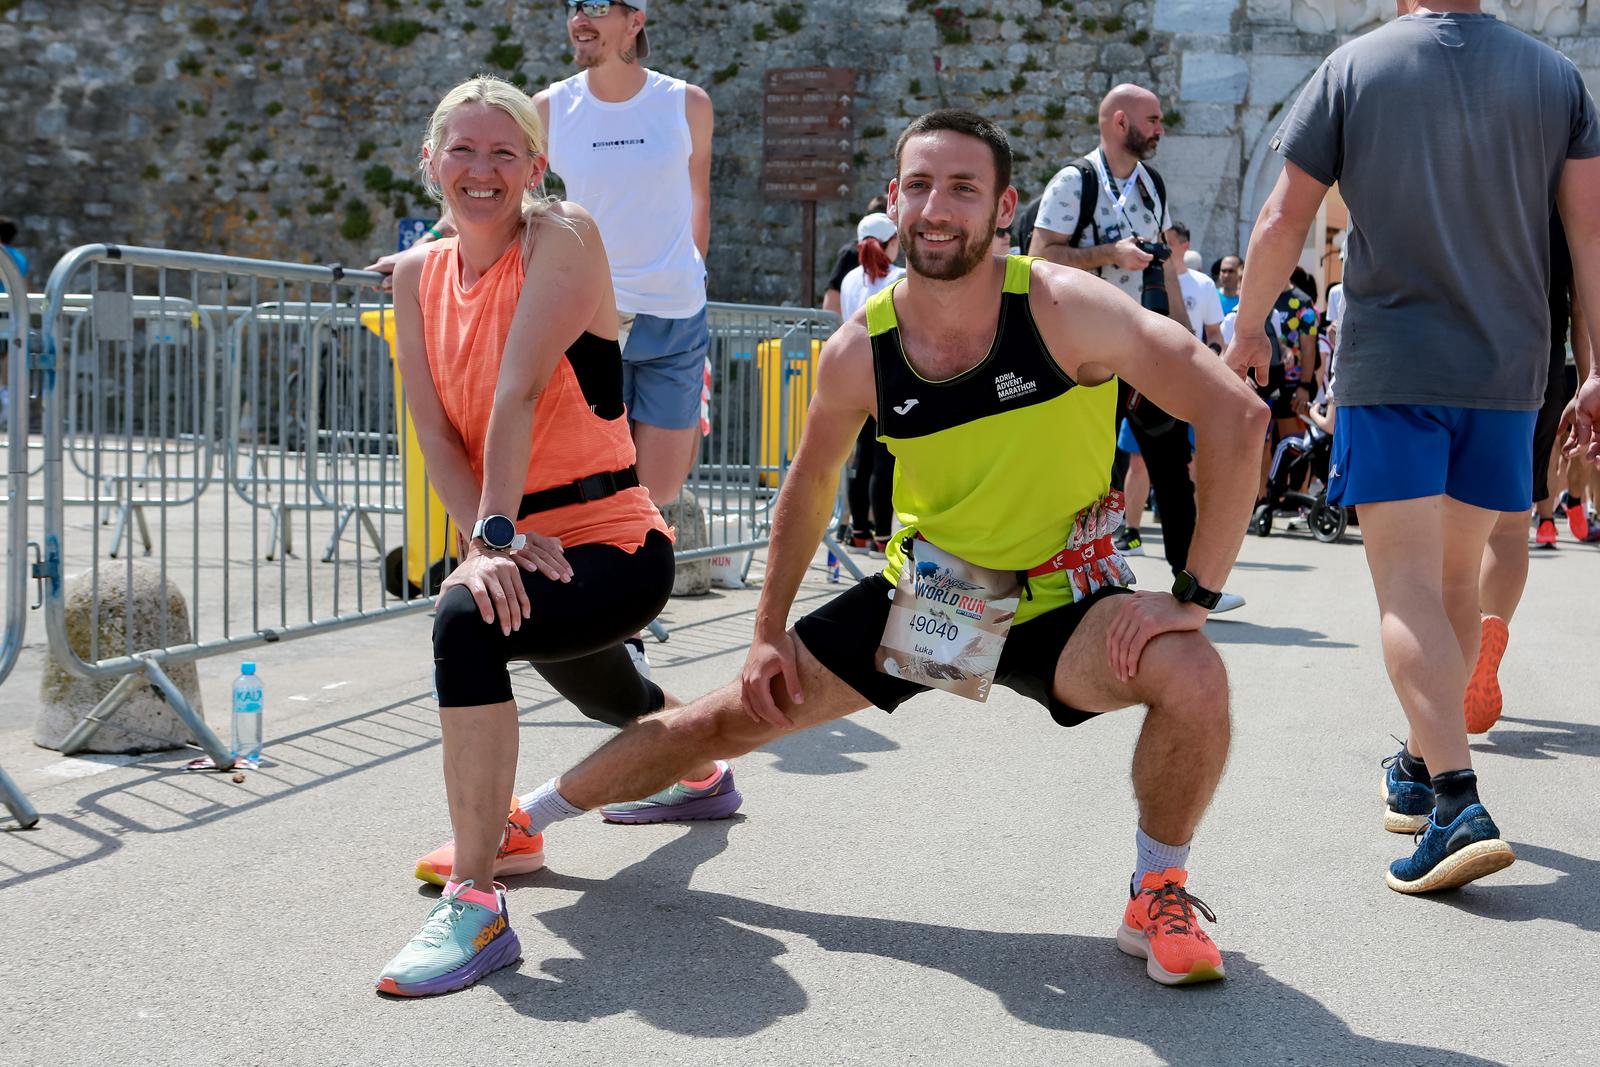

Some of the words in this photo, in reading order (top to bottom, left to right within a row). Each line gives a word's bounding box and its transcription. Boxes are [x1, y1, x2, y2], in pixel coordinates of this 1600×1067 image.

[995, 372, 1015, 384] ADRIA
[996, 376, 1023, 391] ADVENT
[998, 380, 1036, 398] MARATHON
[934, 574, 966, 589] WINGS
[935, 580, 953, 591] LIFE
[917, 582, 960, 606] WORLD
[958, 595, 986, 615] RUN
[914, 644, 934, 656] Luka
[472, 914, 506, 954] HOKA
